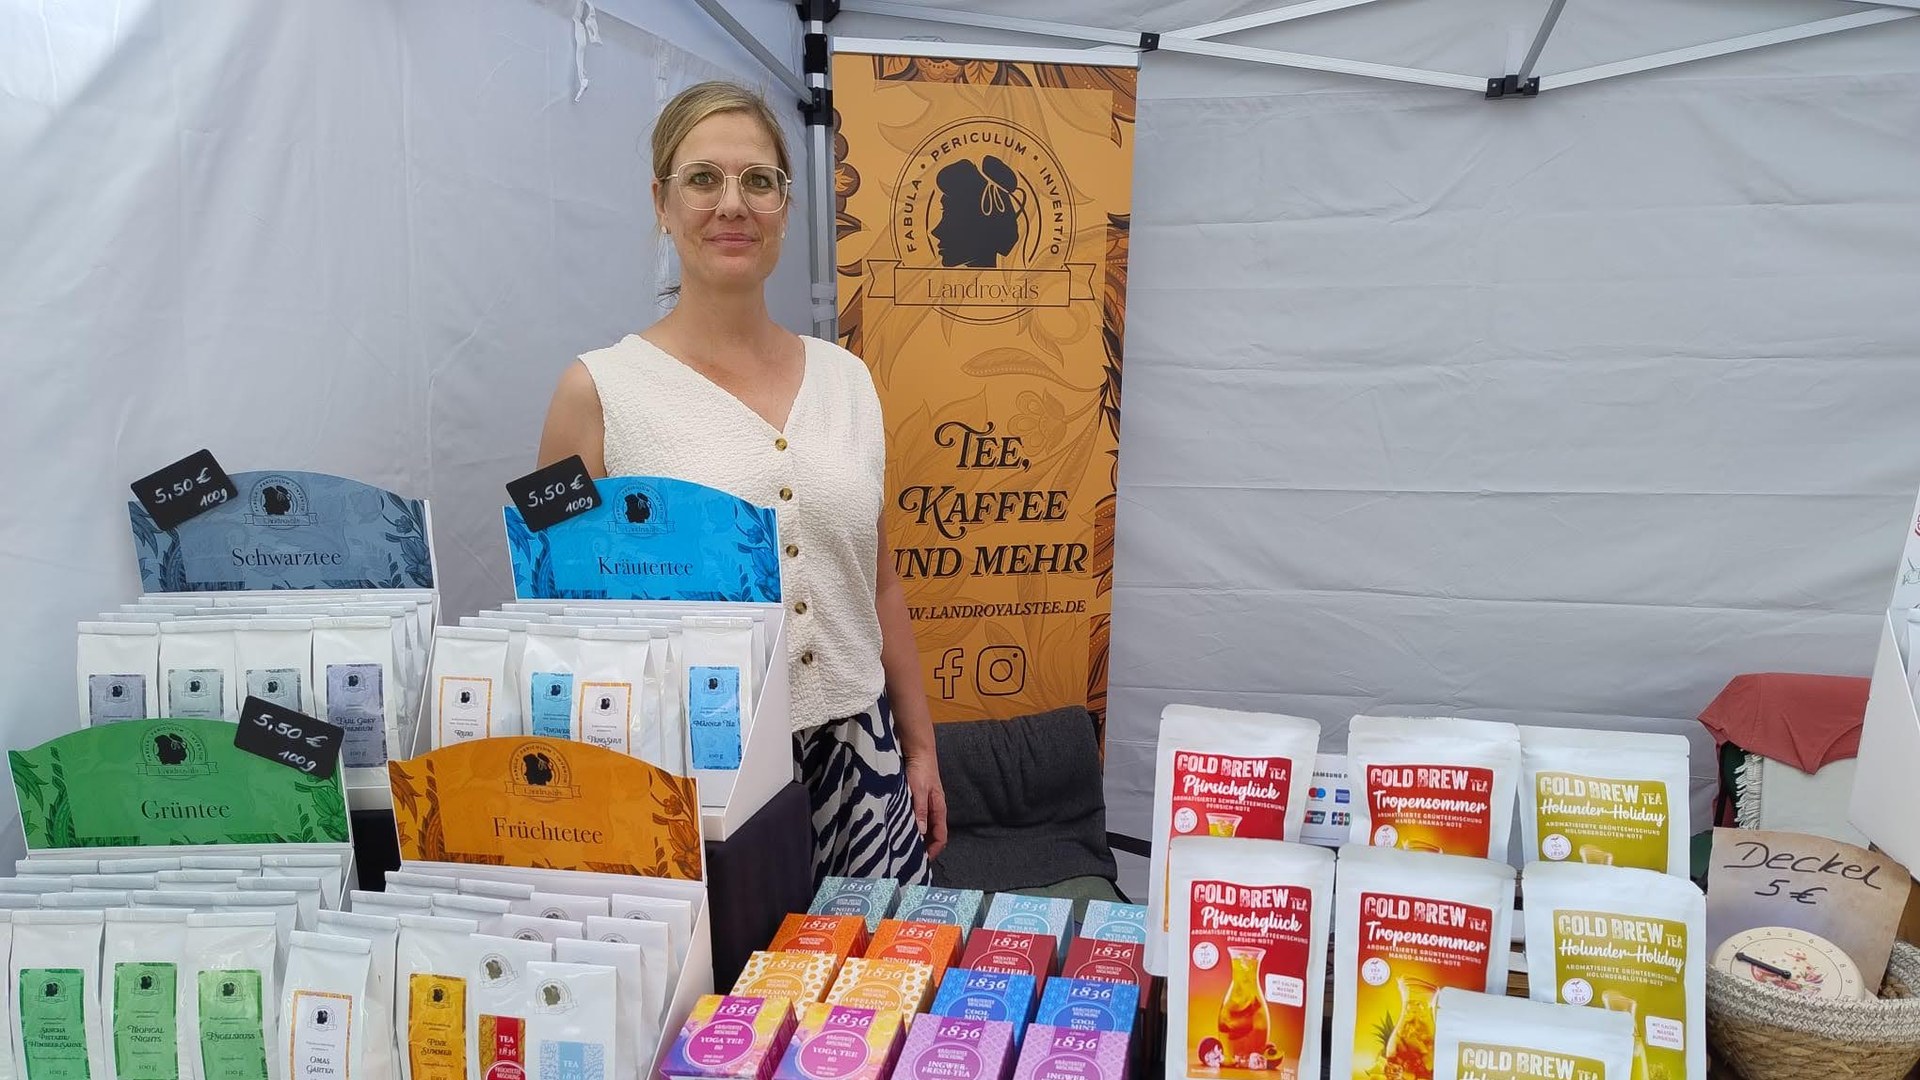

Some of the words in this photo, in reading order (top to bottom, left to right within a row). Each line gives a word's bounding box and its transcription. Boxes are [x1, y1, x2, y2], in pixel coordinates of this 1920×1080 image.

[905, 178, 923, 253] FABULA
[931, 132, 1027, 161] PERICULUM
[1039, 166, 1064, 255] INVENTIO
[926, 277, 1040, 302] Landroyals
[934, 421, 1032, 471] TEE,
[154, 477, 195, 504] 5,50
[195, 467, 212, 484] €
[526, 481, 567, 508] 5,50
[569, 474, 585, 491] €
[199, 488, 228, 507] 100g
[565, 495, 594, 513] 100g
[899, 485, 1069, 540] KAFFEE
[231, 547, 342, 567] Schwarztee
[597, 556, 694, 577] Kräutertee
[970, 542, 1088, 577] MEHR
[908, 600, 1087, 621] W.LANDROYALSTEE.DE
[253, 713, 303, 739] 5,50
[305, 735, 329, 748] €
[278, 751, 317, 772] 100g
[1177, 754, 1218, 774] COLD
[1221, 758, 1269, 779] BREW
[1269, 767, 1287, 781] TEA
[1182, 774, 1281, 800] Pfirsichglück
[1370, 768, 1414, 788] COLD
[1417, 768, 1469, 791] BREW
[1470, 779, 1488, 793] TEA
[1539, 776, 1586, 797] COLD
[1588, 780, 1640, 804] BREW
[1641, 792, 1663, 805] TEA
[141, 799, 232, 820] Grüntee
[1372, 789, 1488, 814] Tropensommer
[493, 816, 603, 844] Früchtetee
[1722, 841, 1882, 890] Deckel
[840, 882, 874, 892] 1836
[925, 892, 959, 903] 1836
[1013, 901, 1048, 912] 1836
[1194, 884, 1237, 905] COLD
[1239, 888, 1289, 909] BREW
[1290, 897, 1308, 912] TEA
[1110, 908, 1146, 920] 1836
[1200, 906, 1303, 933] Pfirsichglück
[1364, 896, 1410, 920] COLD
[1414, 901, 1467, 928] BREW
[1468, 917, 1488, 932] TEA
[803, 920, 839, 931] 1836
[898, 927, 936, 939] 1836
[1558, 914, 1608, 937] COLD
[1611, 918, 1664, 945] BREW
[1665, 933, 1683, 949] TEA
[992, 937, 1030, 950] 1836
[1365, 920, 1487, 954] Tropensommer
[1094, 946, 1133, 959] 1836
[769, 959, 809, 972] 1836
[866, 967, 905, 980] 1836
[968, 977, 1008, 991] 1836
[1071, 986, 1112, 1000] 1836
[719, 1003, 760, 1017] 1836
[964, 1008, 989, 1016] COOL
[828, 1013, 872, 1028] 1836
[1070, 1018, 1096, 1026] COOL
[499, 1035, 514, 1044] TEA
[701, 1036, 724, 1044] YOGA
[939, 1025, 982, 1040] 1836
[498, 1047, 517, 1057] 1836
[813, 1046, 837, 1055] YOGA
[840, 1049, 858, 1058] TEE
[1053, 1036, 1098, 1052] 1836
[563, 1060, 579, 1068] TEA
[1462, 1047, 1512, 1071] COLD
[1516, 1052, 1575, 1080] BREW
